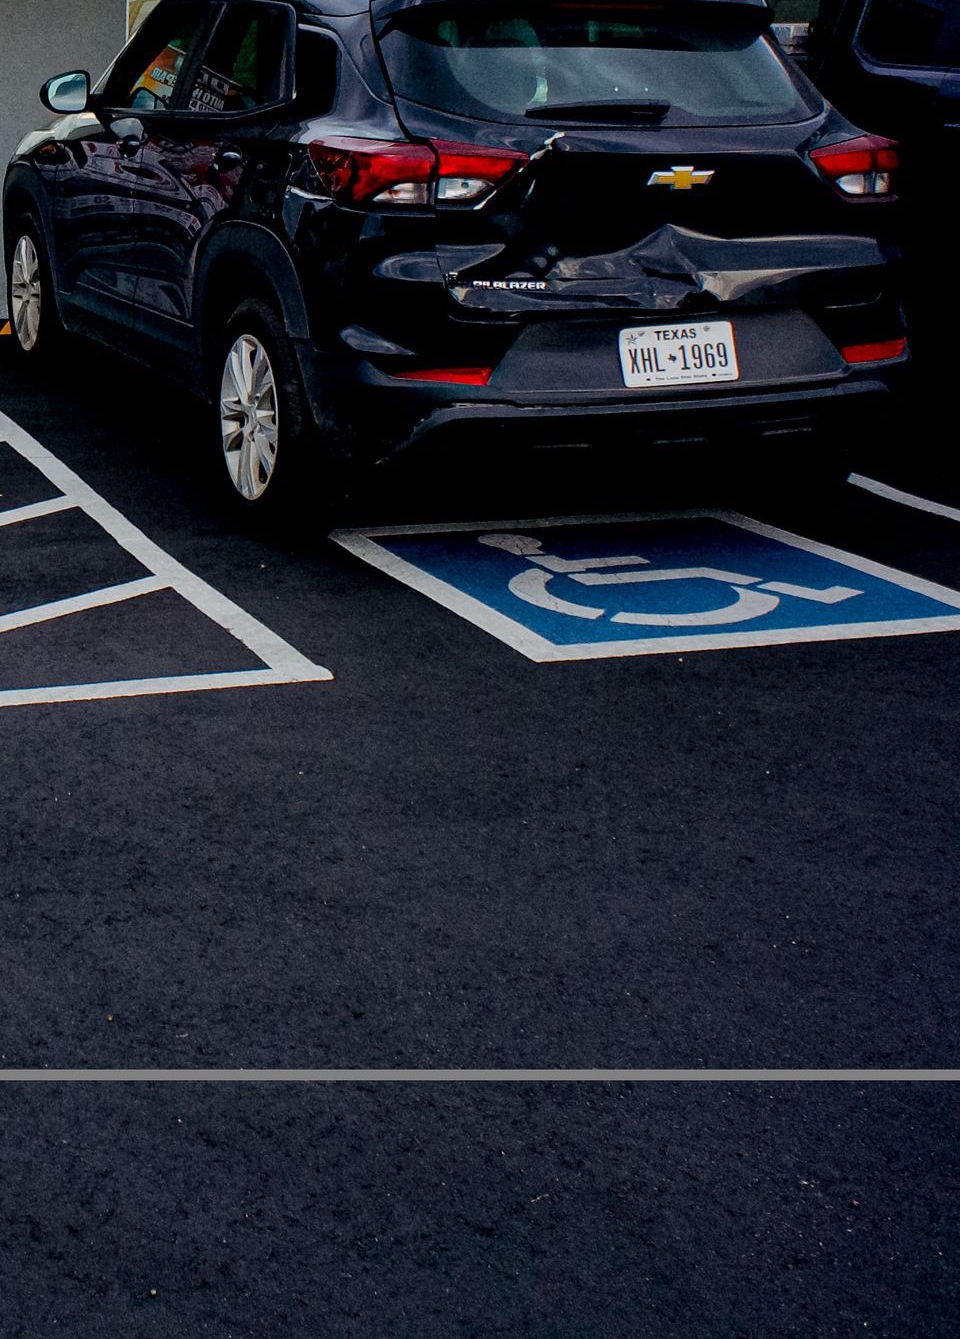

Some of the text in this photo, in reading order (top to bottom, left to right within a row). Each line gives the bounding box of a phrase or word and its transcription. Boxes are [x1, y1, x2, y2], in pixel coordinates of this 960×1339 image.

[654, 328, 697, 341] TEXAS
[628, 342, 729, 374] XHL 1969
